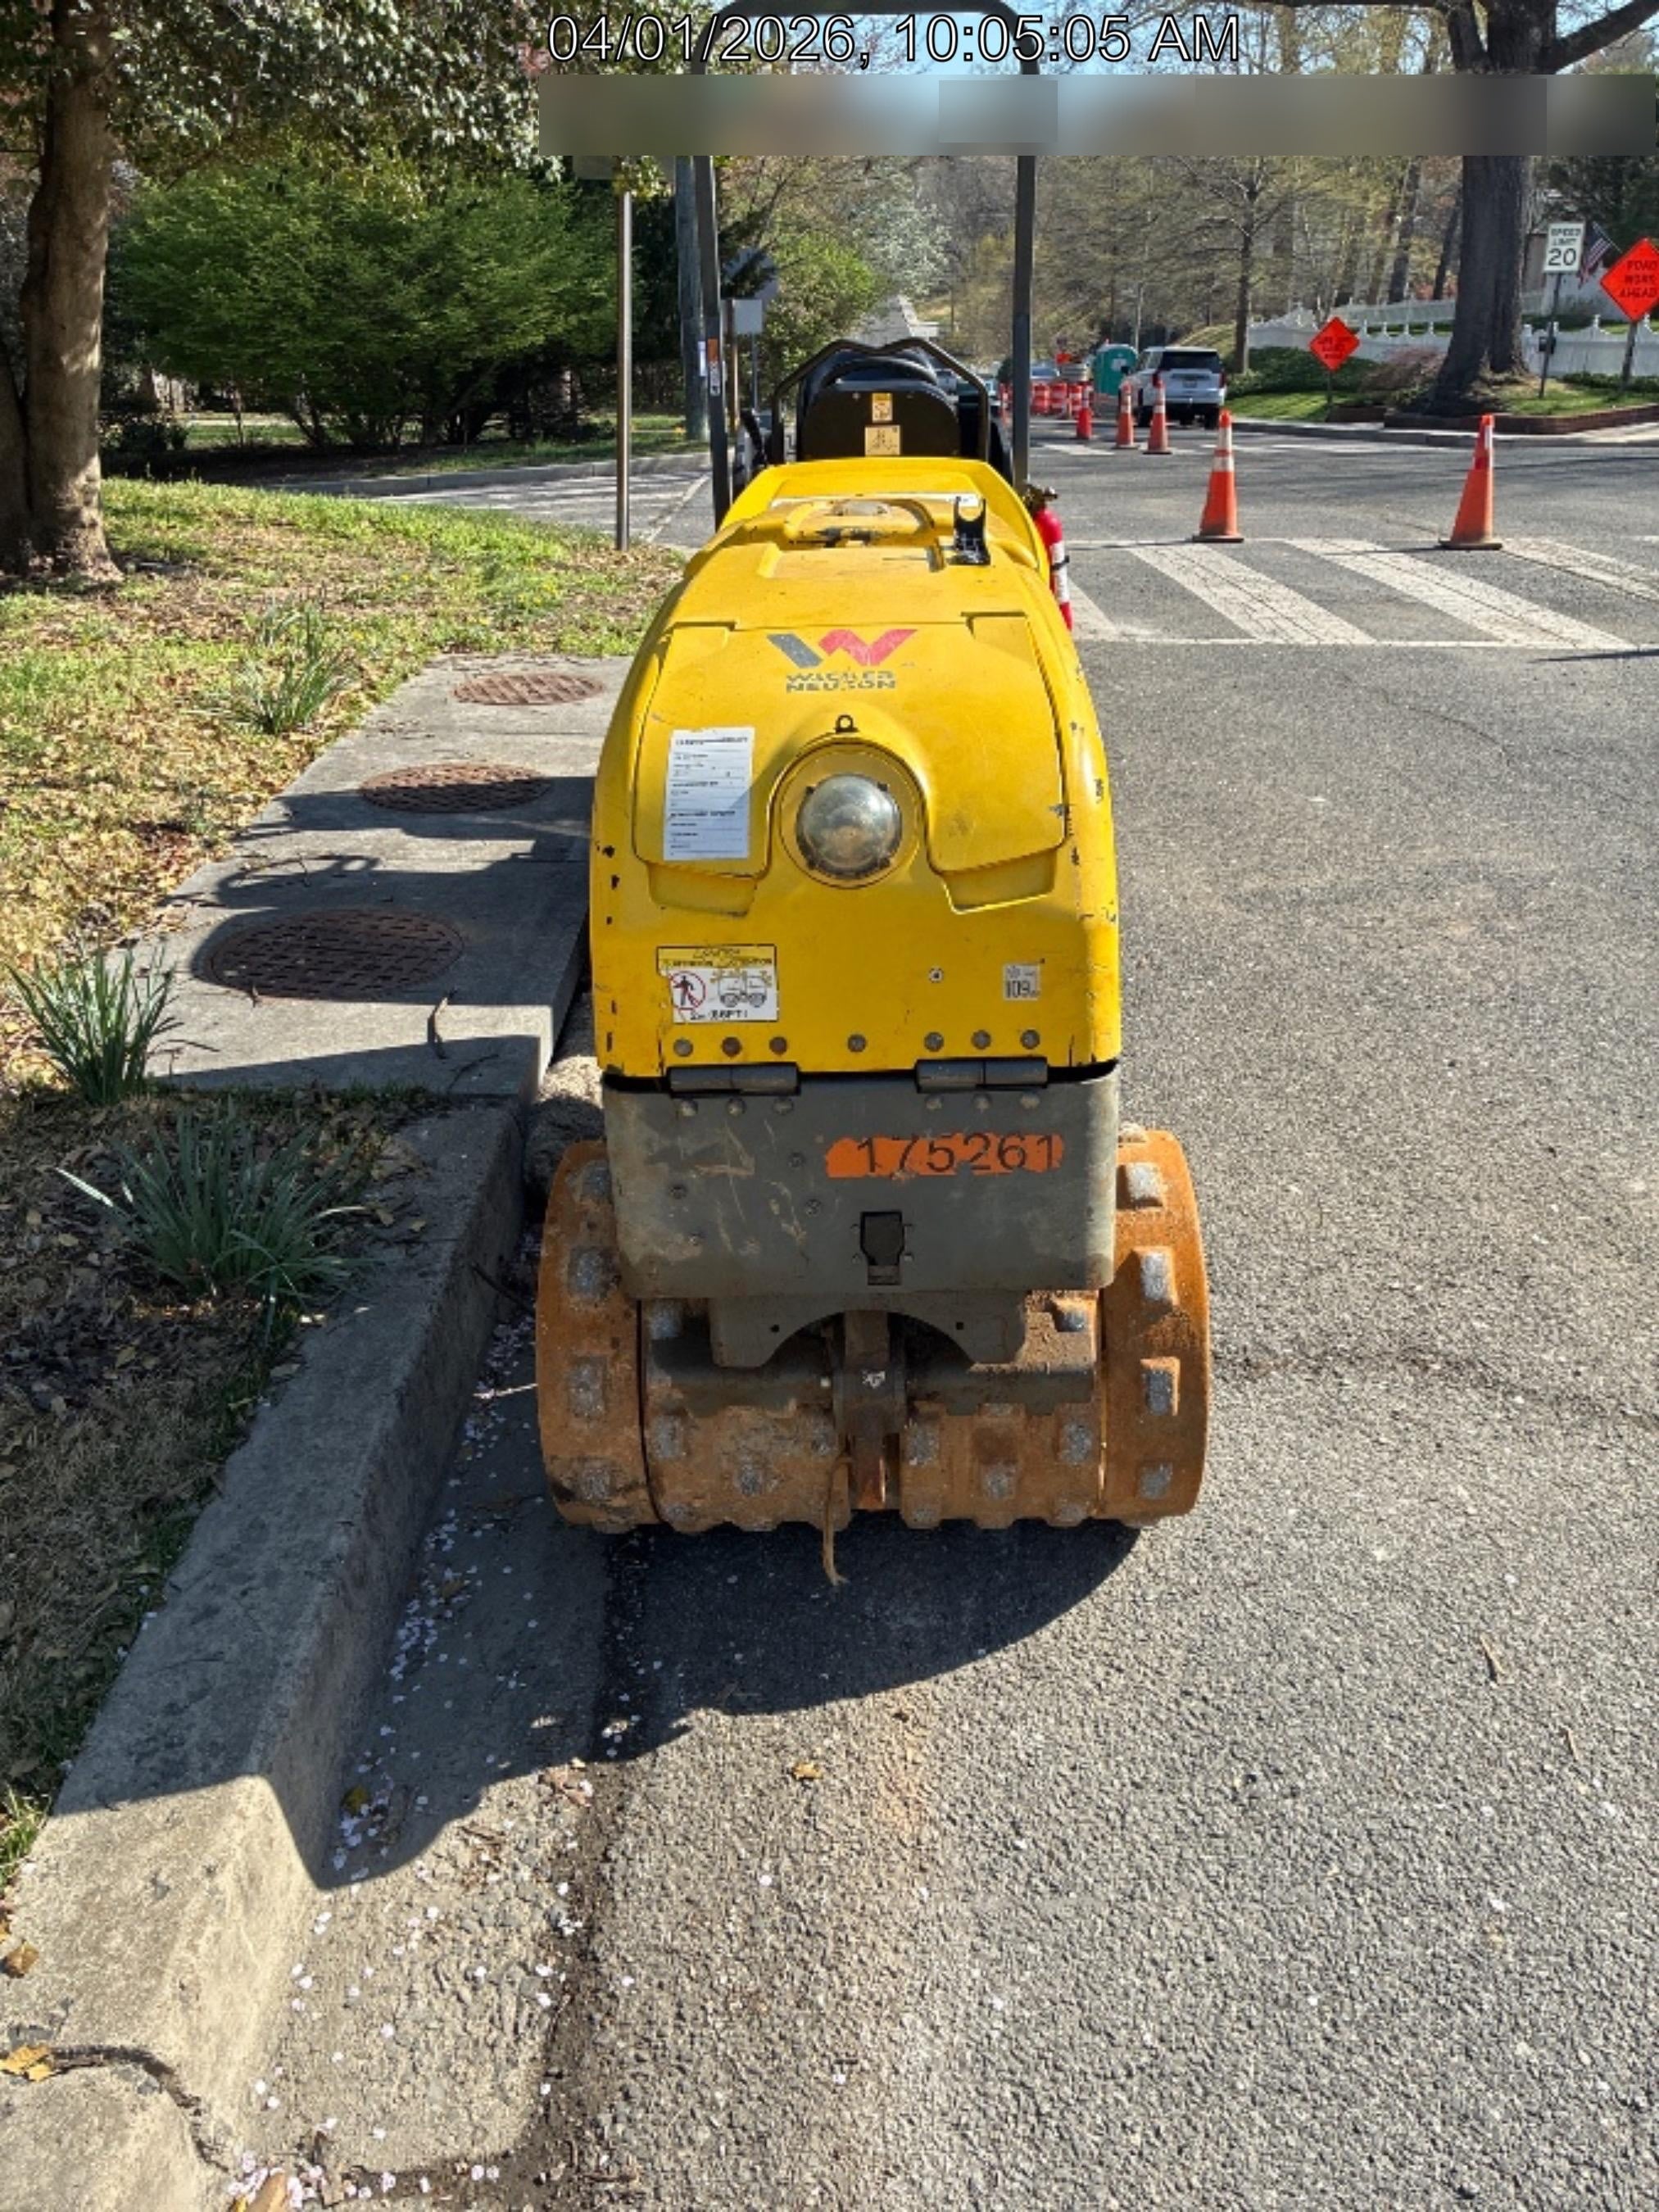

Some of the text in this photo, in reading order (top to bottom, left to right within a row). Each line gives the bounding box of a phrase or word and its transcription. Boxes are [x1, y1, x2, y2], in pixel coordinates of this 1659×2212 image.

[1548, 248, 1576, 265] 20
[1618, 288, 1657, 297] AHEAD
[857, 1133, 1053, 1173] 175261
